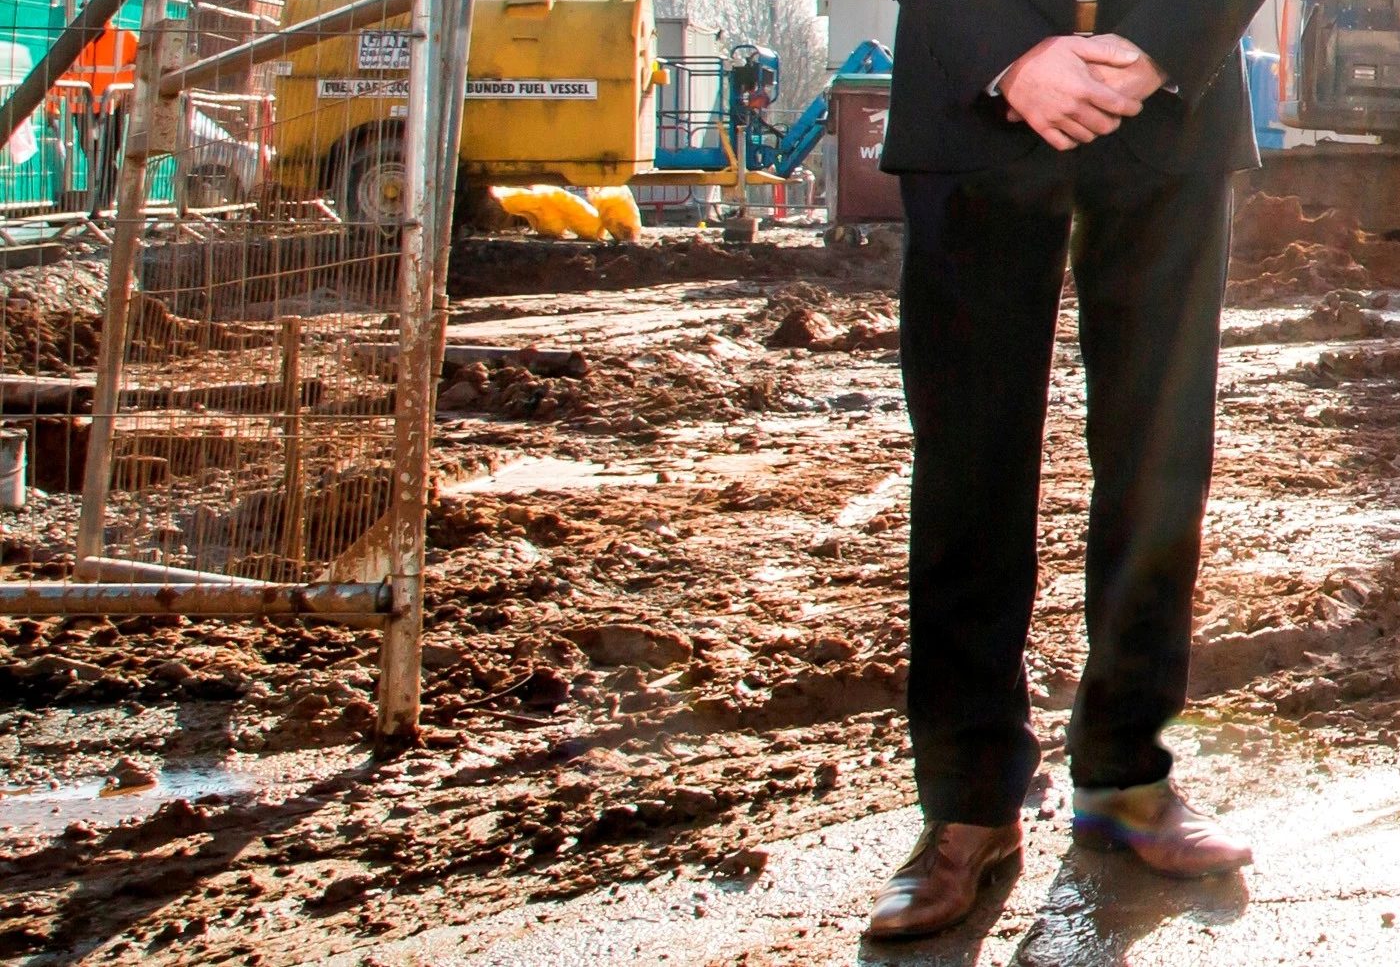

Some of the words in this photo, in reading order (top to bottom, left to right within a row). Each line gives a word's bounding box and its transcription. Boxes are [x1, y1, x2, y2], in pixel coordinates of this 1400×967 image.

[466, 83, 515, 94] BUNDED
[519, 83, 546, 94] FUEL
[550, 83, 590, 94] VESSEL
